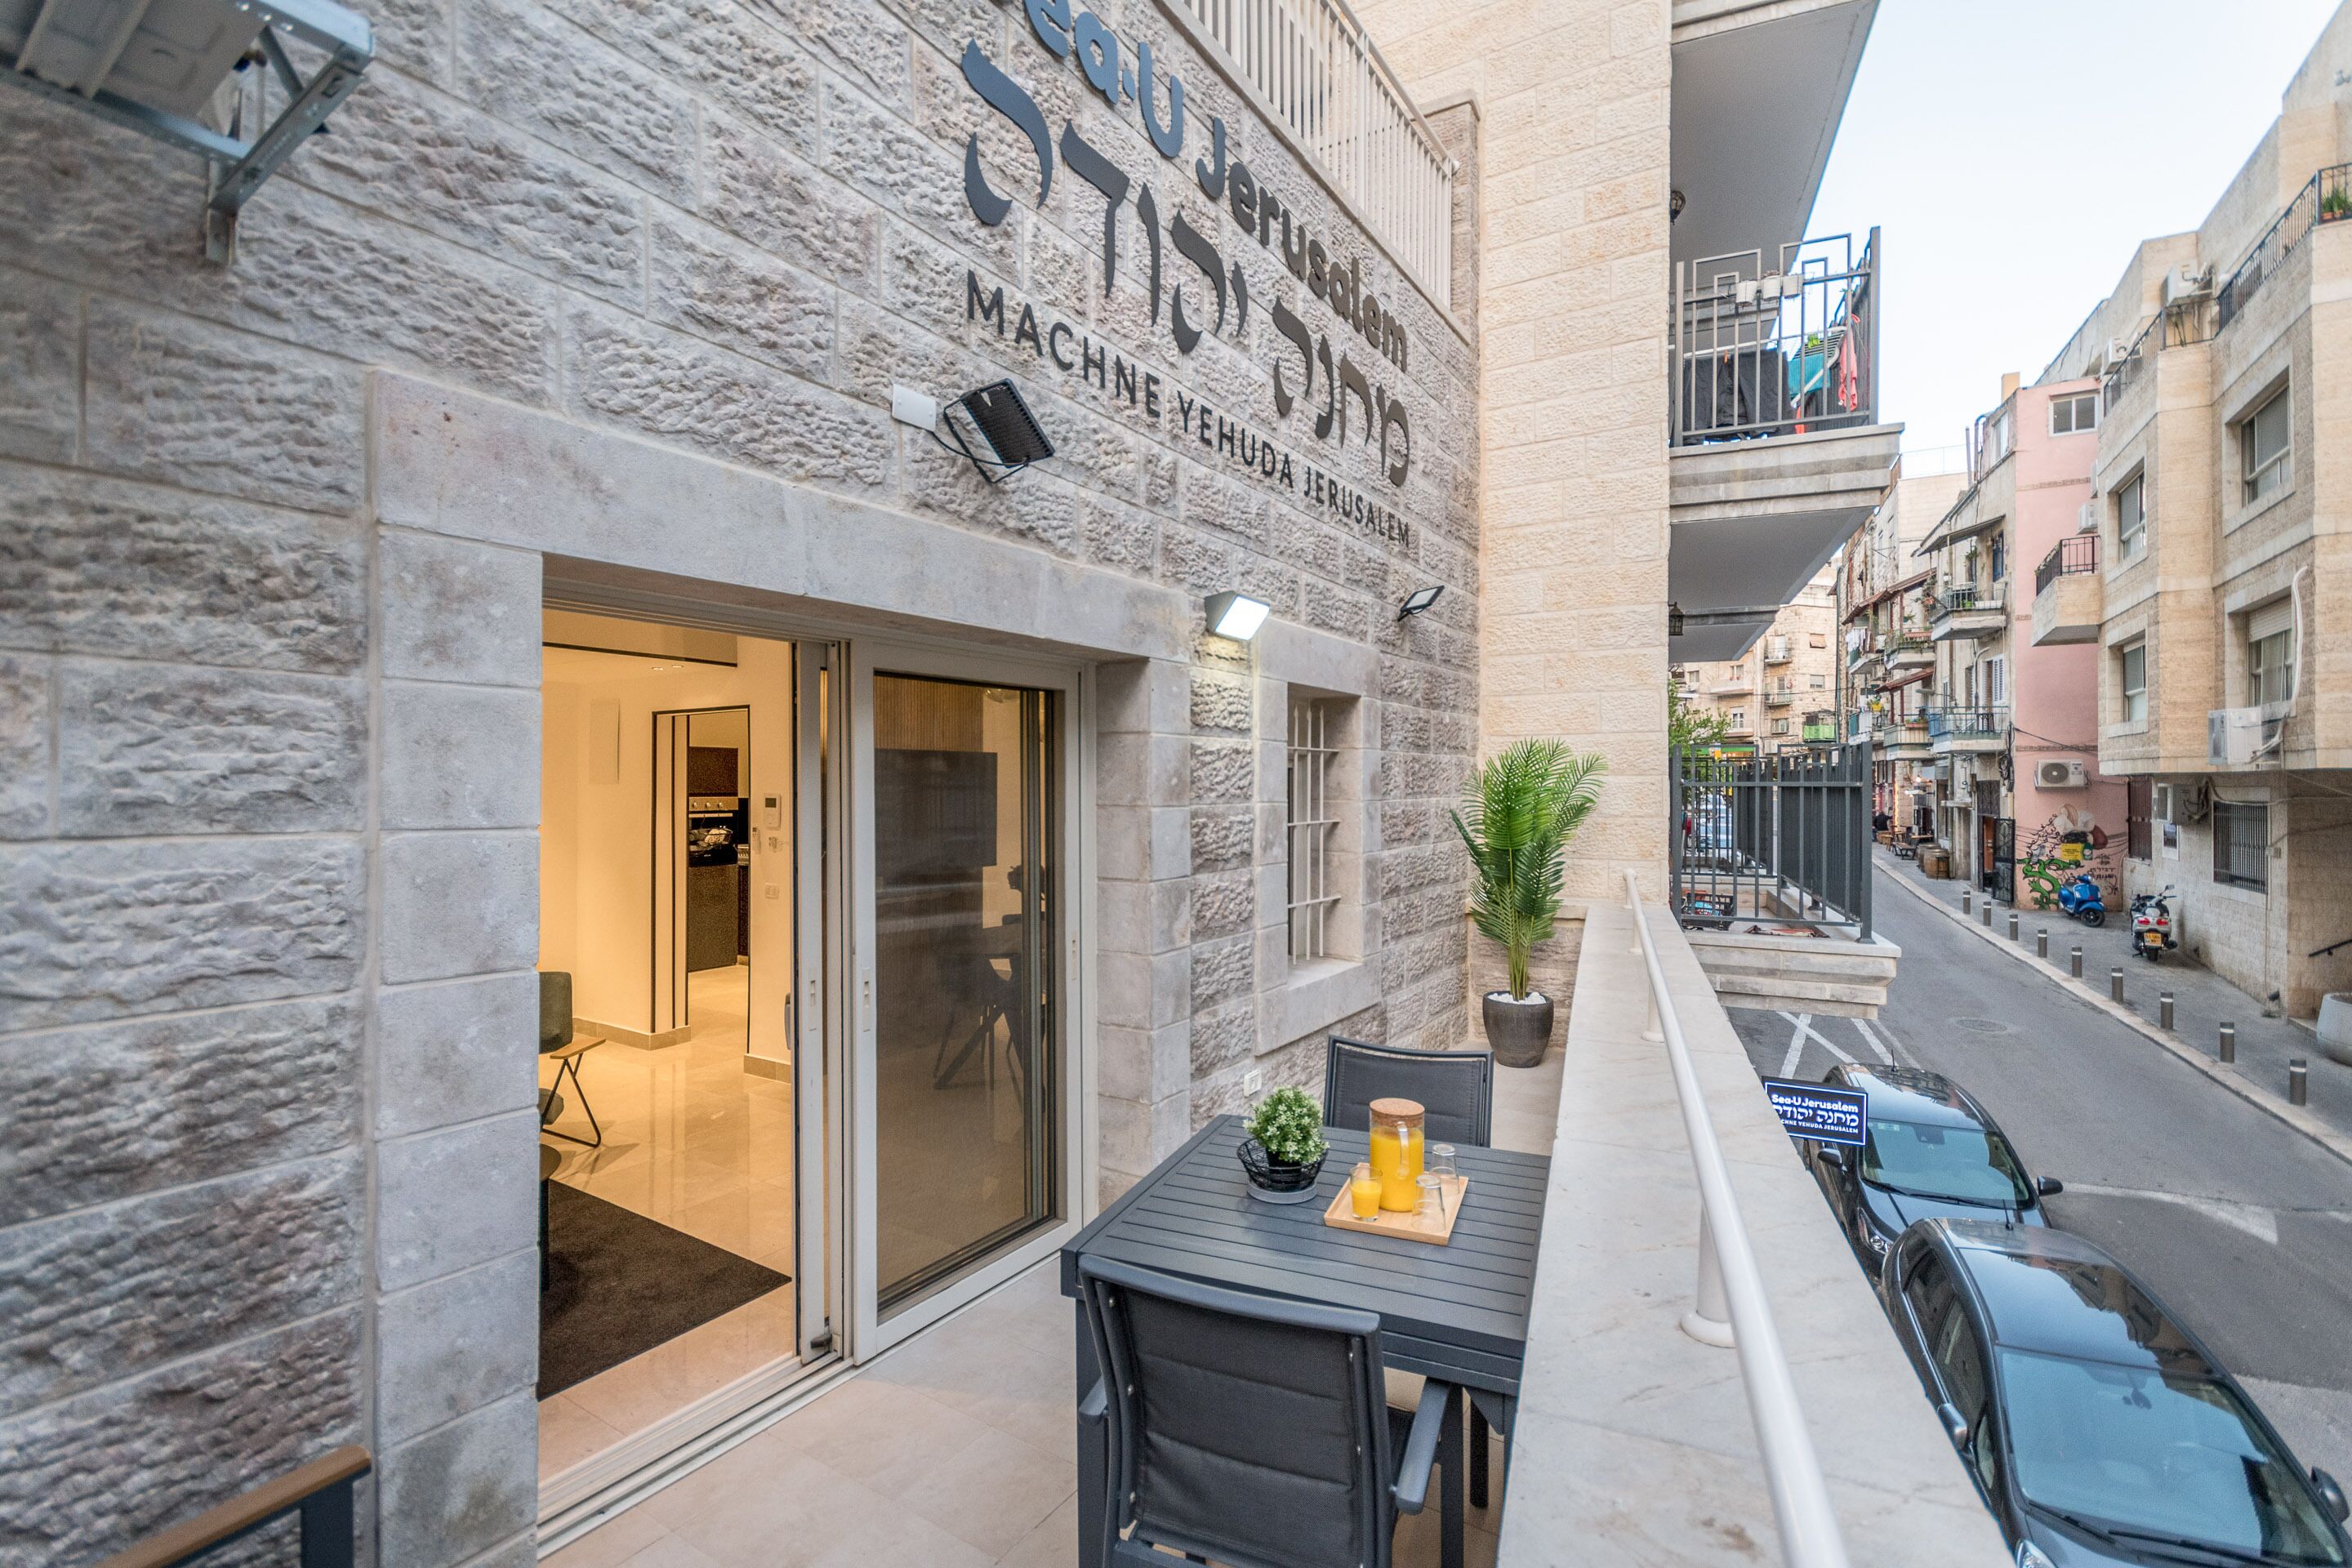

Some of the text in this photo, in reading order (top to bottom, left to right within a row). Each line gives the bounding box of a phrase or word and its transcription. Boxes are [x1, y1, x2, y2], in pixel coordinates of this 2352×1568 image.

[961, 38, 1410, 487] מחנה יהודה
[1196, 117, 1409, 373] Jerusalem
[967, 269, 1410, 548] MACHNE YEHUDA JERUSALEM
[1798, 1120, 1823, 1129] YEHUDA
[1824, 1125, 1859, 1134] JERUSALEM
[1802, 1098, 1859, 1113] Jerusalem
[1816, 1110, 1860, 1127] מחנה
